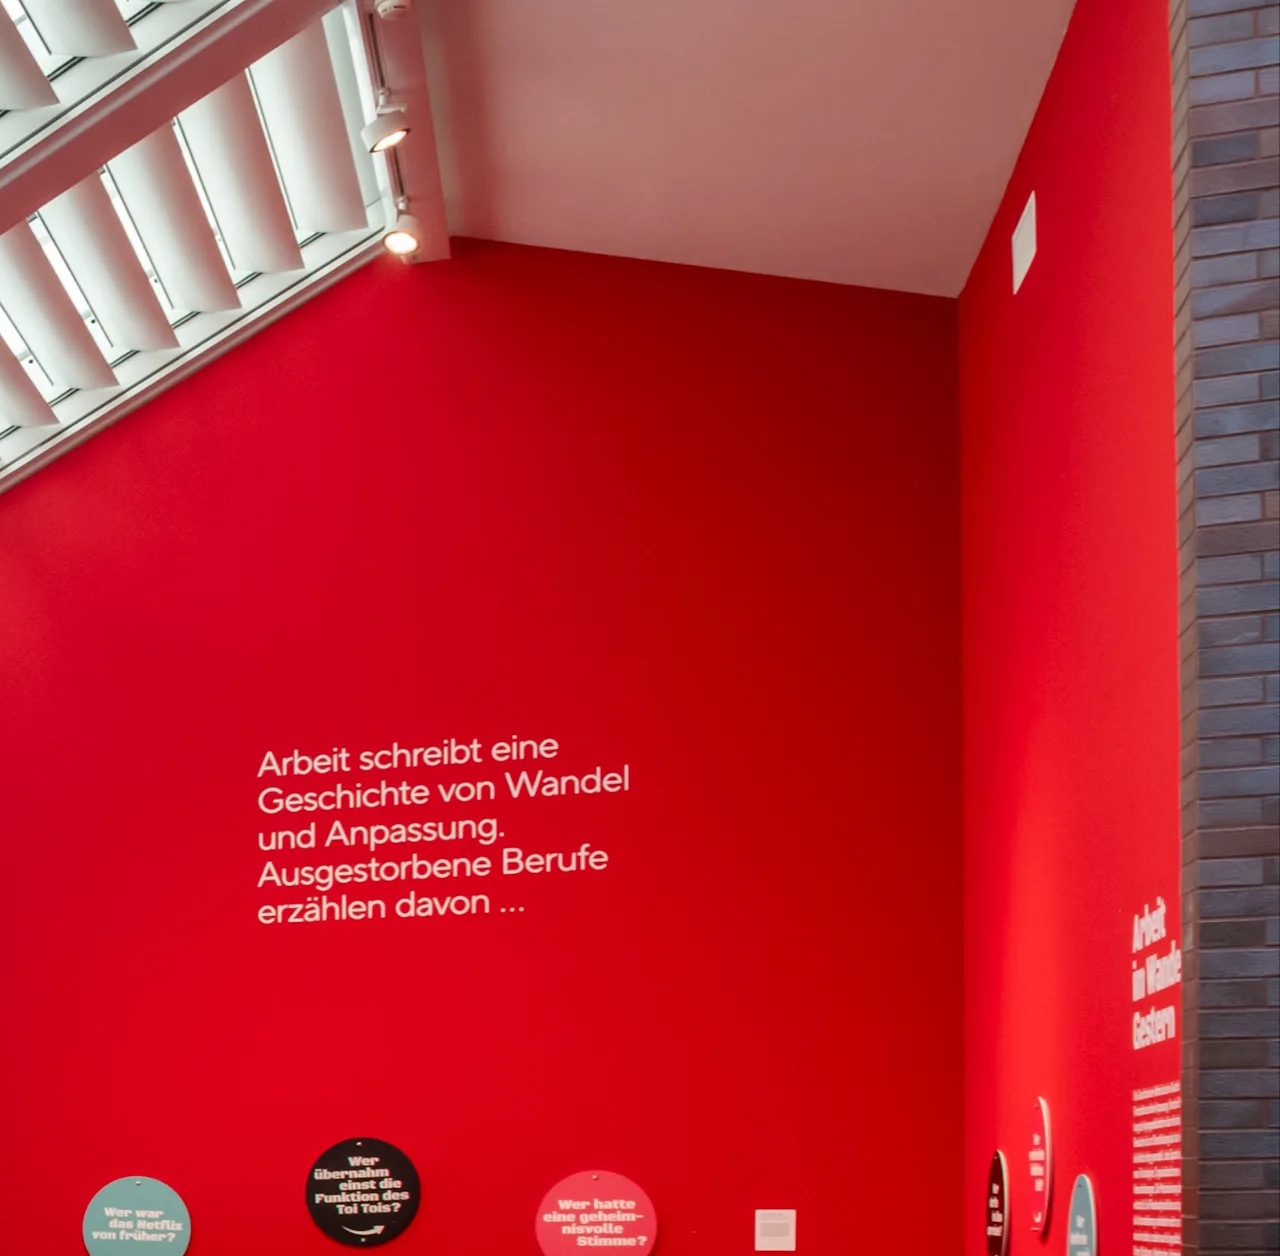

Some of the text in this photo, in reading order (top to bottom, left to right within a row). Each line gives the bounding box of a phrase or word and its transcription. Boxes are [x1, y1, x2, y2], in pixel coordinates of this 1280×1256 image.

[258, 735, 558, 777] Arbeit schreibt eine
[258, 765, 628, 813] Geschichte von Wandel
[259, 817, 505, 852] und Anpassung.
[257, 844, 608, 891] Ausgestorbene Berufe
[258, 890, 385, 924] erzählen
[396, 891, 489, 917] davon
[1132, 896, 1166, 953] Arbeit
[1132, 940, 1182, 1002] im Wande
[1133, 1006, 1176, 1050] Gestern
[348, 1156, 380, 1166] Wer
[314, 1167, 390, 1180] übernahm
[339, 1178, 402, 1190] einst die
[315, 1190, 410, 1203] Funktion des
[336, 1202, 401, 1214] Toi Tois?
[558, 1198, 636, 1210] Wer hatte
[104, 1207, 164, 1218] Wer war
[543, 1211, 643, 1224] eine geheim-
[109, 1218, 183, 1230] das Netflix
[562, 1223, 623, 1234] nisvolle
[92, 1230, 175, 1242] von früher?
[577, 1235, 647, 1246] Stimme?
